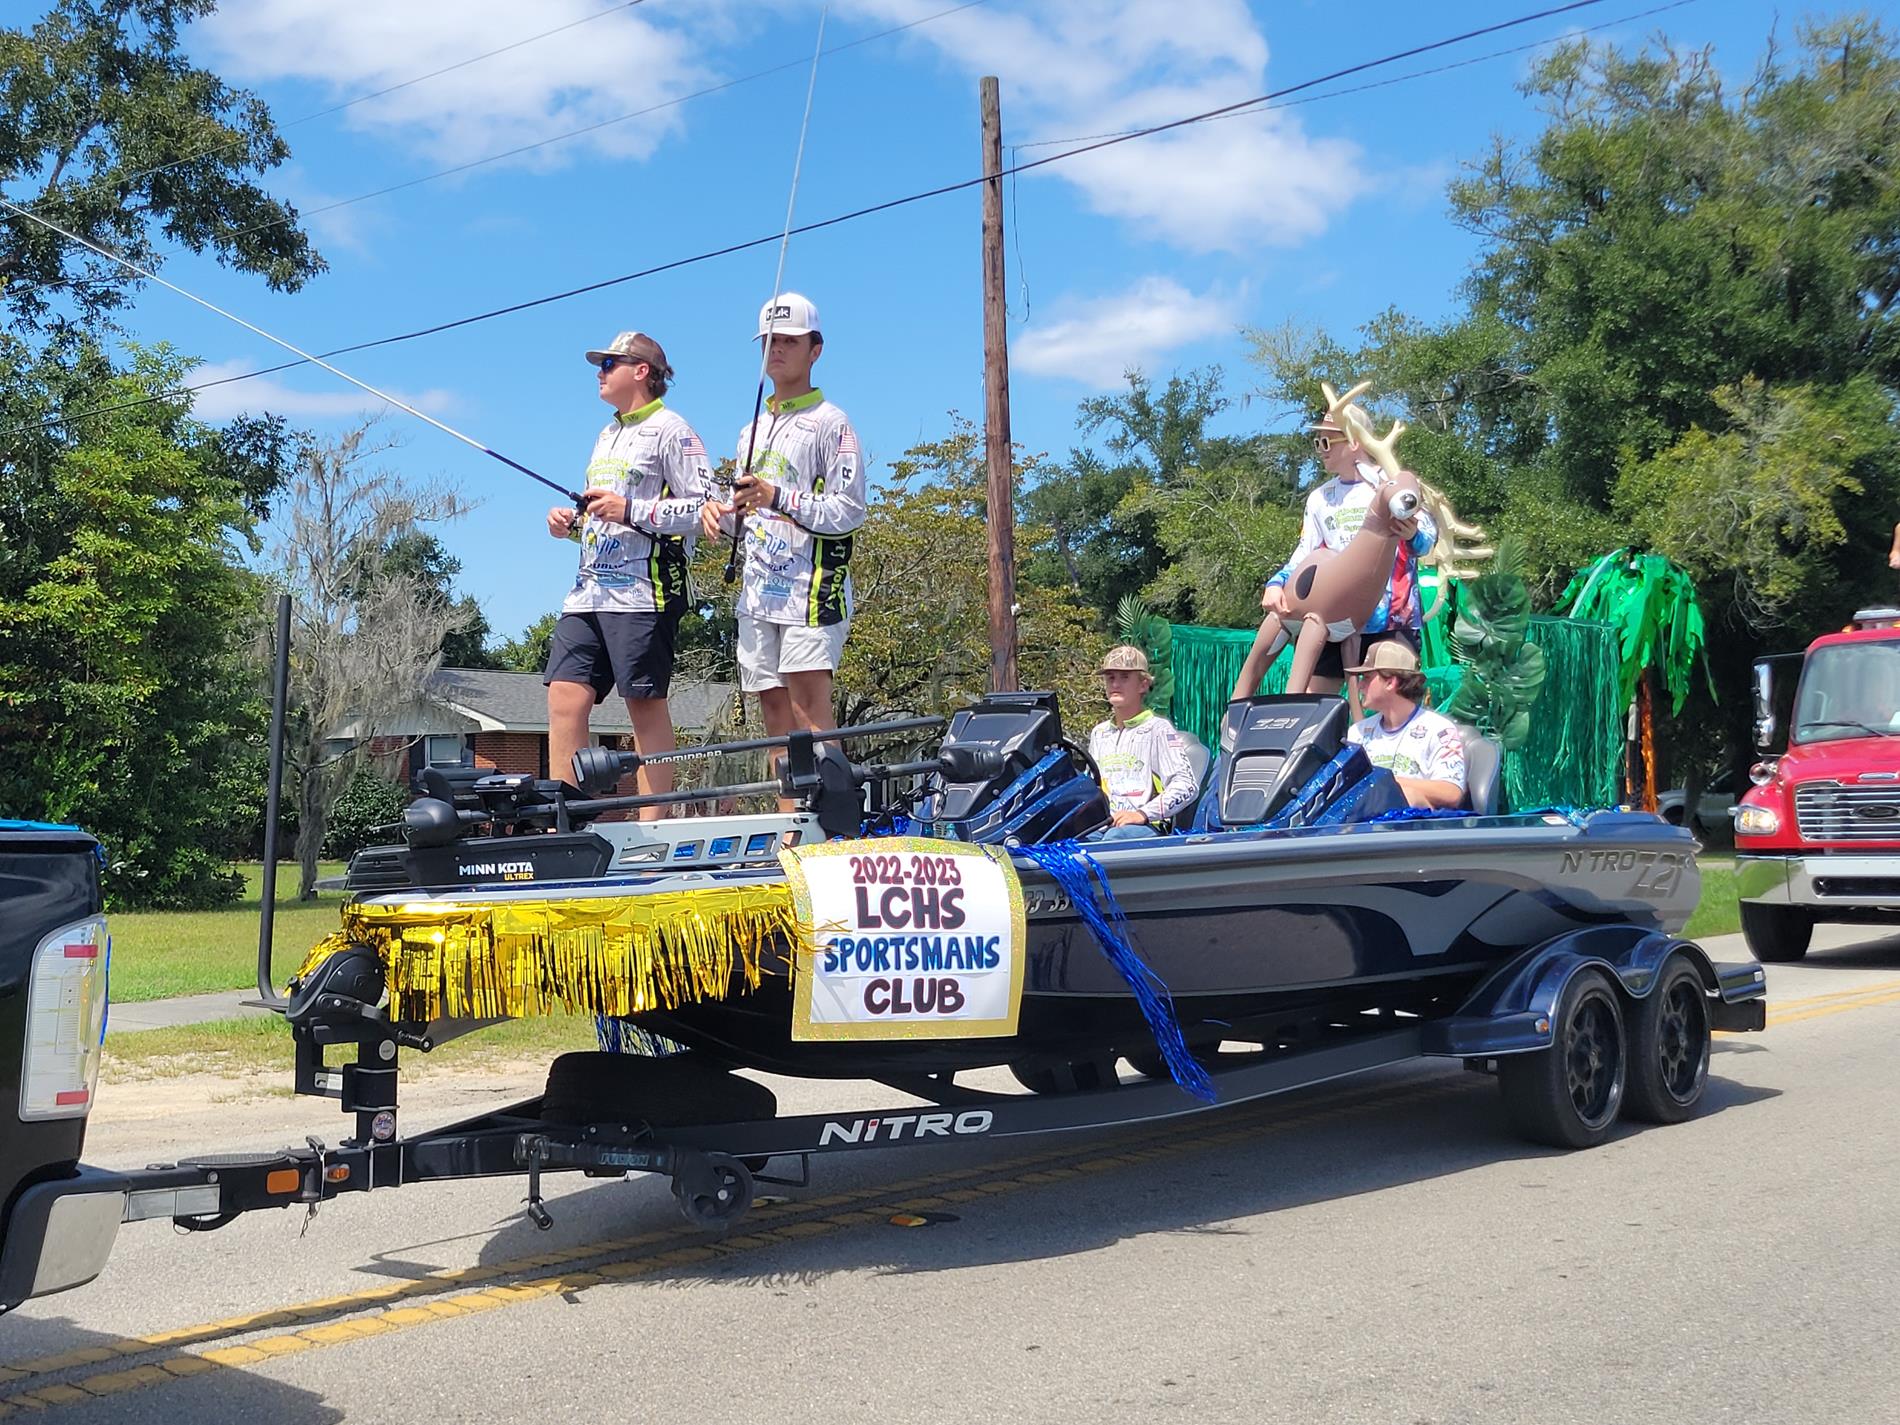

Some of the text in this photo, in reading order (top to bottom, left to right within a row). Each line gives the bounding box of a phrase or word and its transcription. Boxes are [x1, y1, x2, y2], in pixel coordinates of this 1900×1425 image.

[459, 862, 534, 876] MINN KOTA
[504, 872, 534, 881] ULTREX
[849, 855, 962, 885] 2022-2023
[854, 886, 966, 930] LCHS
[824, 936, 1000, 972] SPORTSMANS
[863, 977, 966, 1015] CLUB
